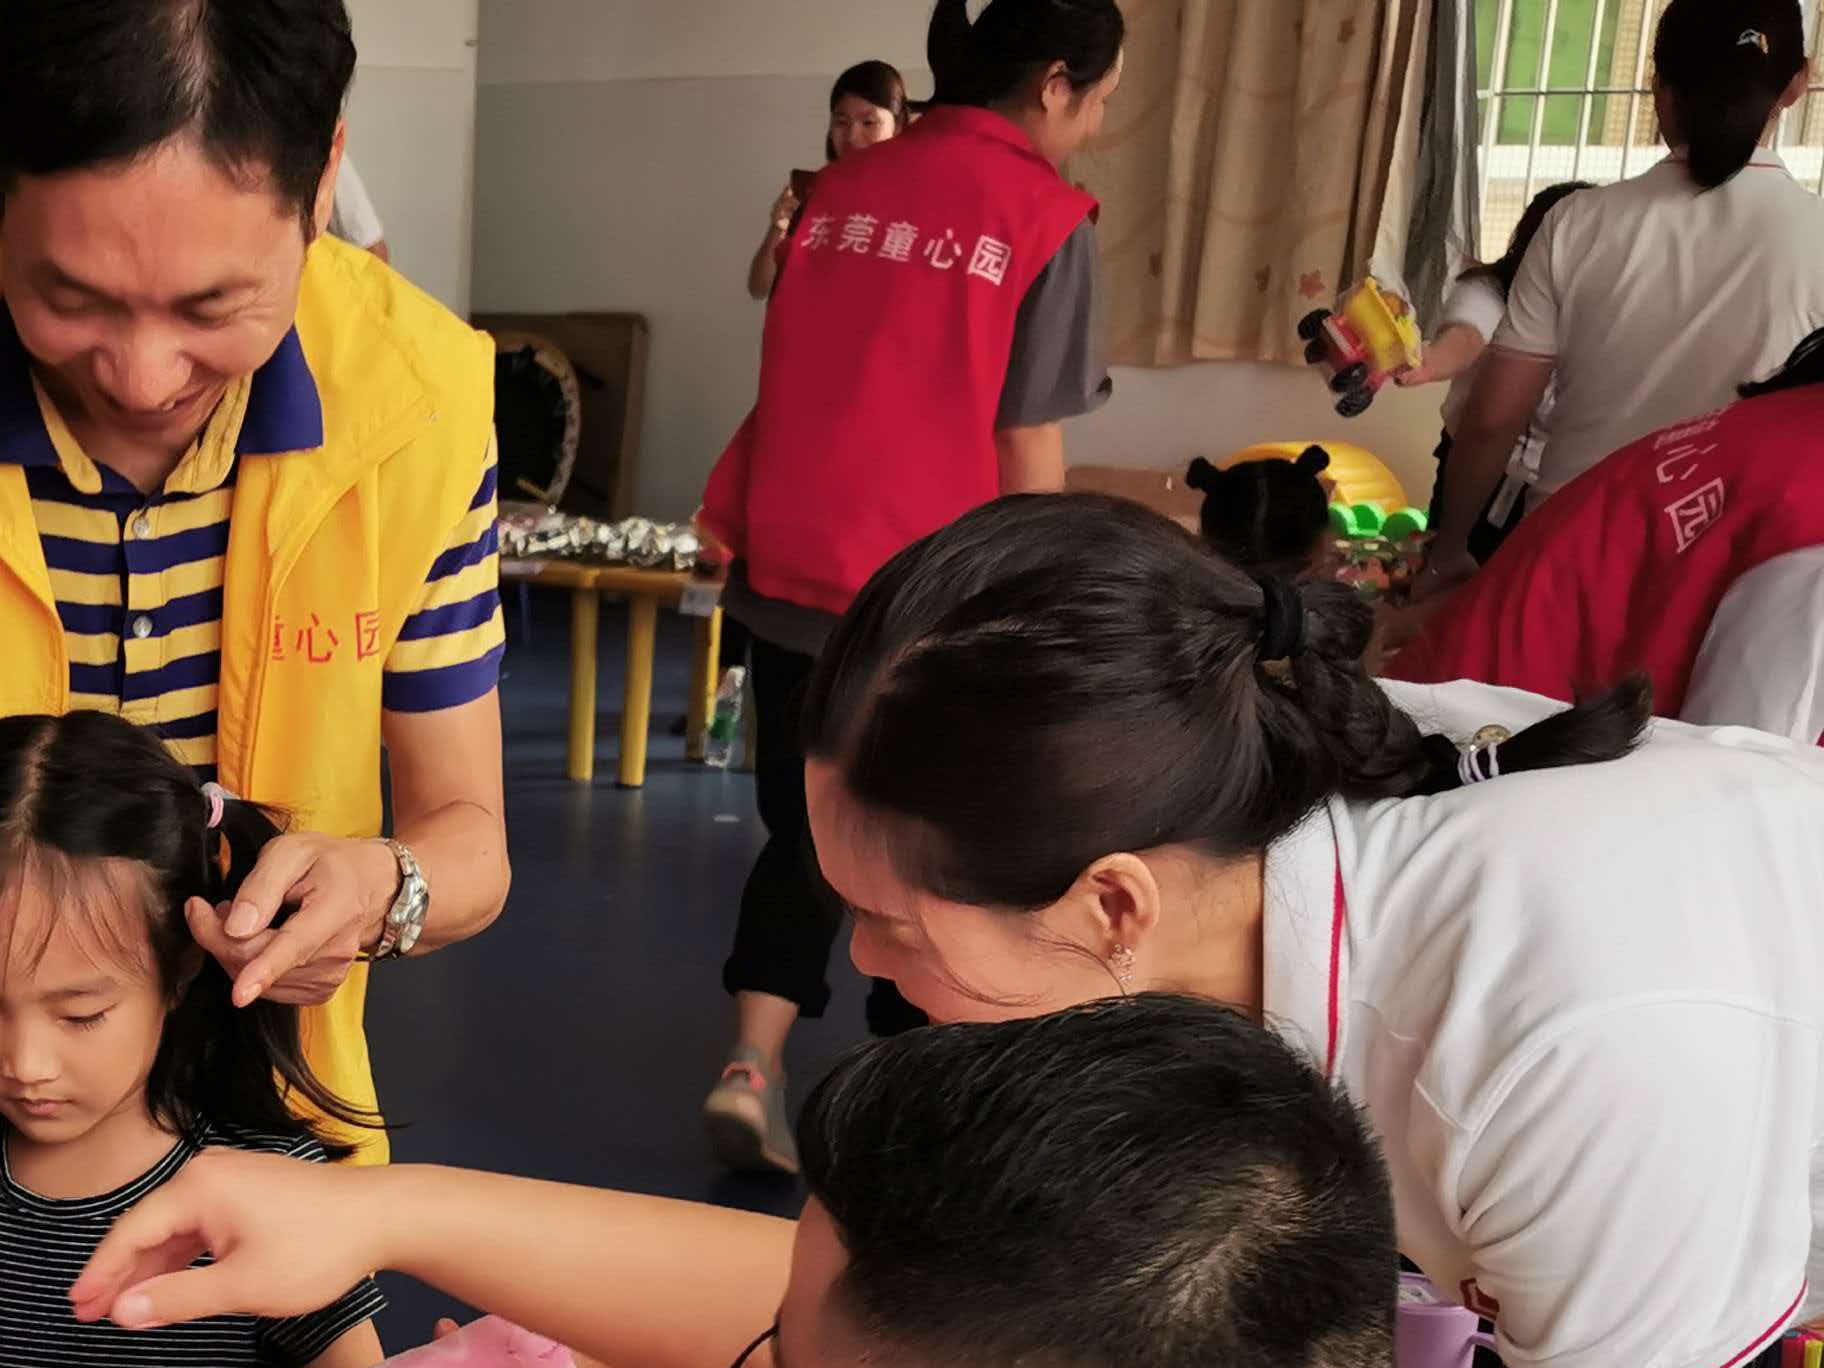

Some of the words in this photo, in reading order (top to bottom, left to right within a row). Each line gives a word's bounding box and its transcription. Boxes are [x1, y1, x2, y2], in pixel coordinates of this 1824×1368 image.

[801, 213, 1022, 286] 东莞童心园
